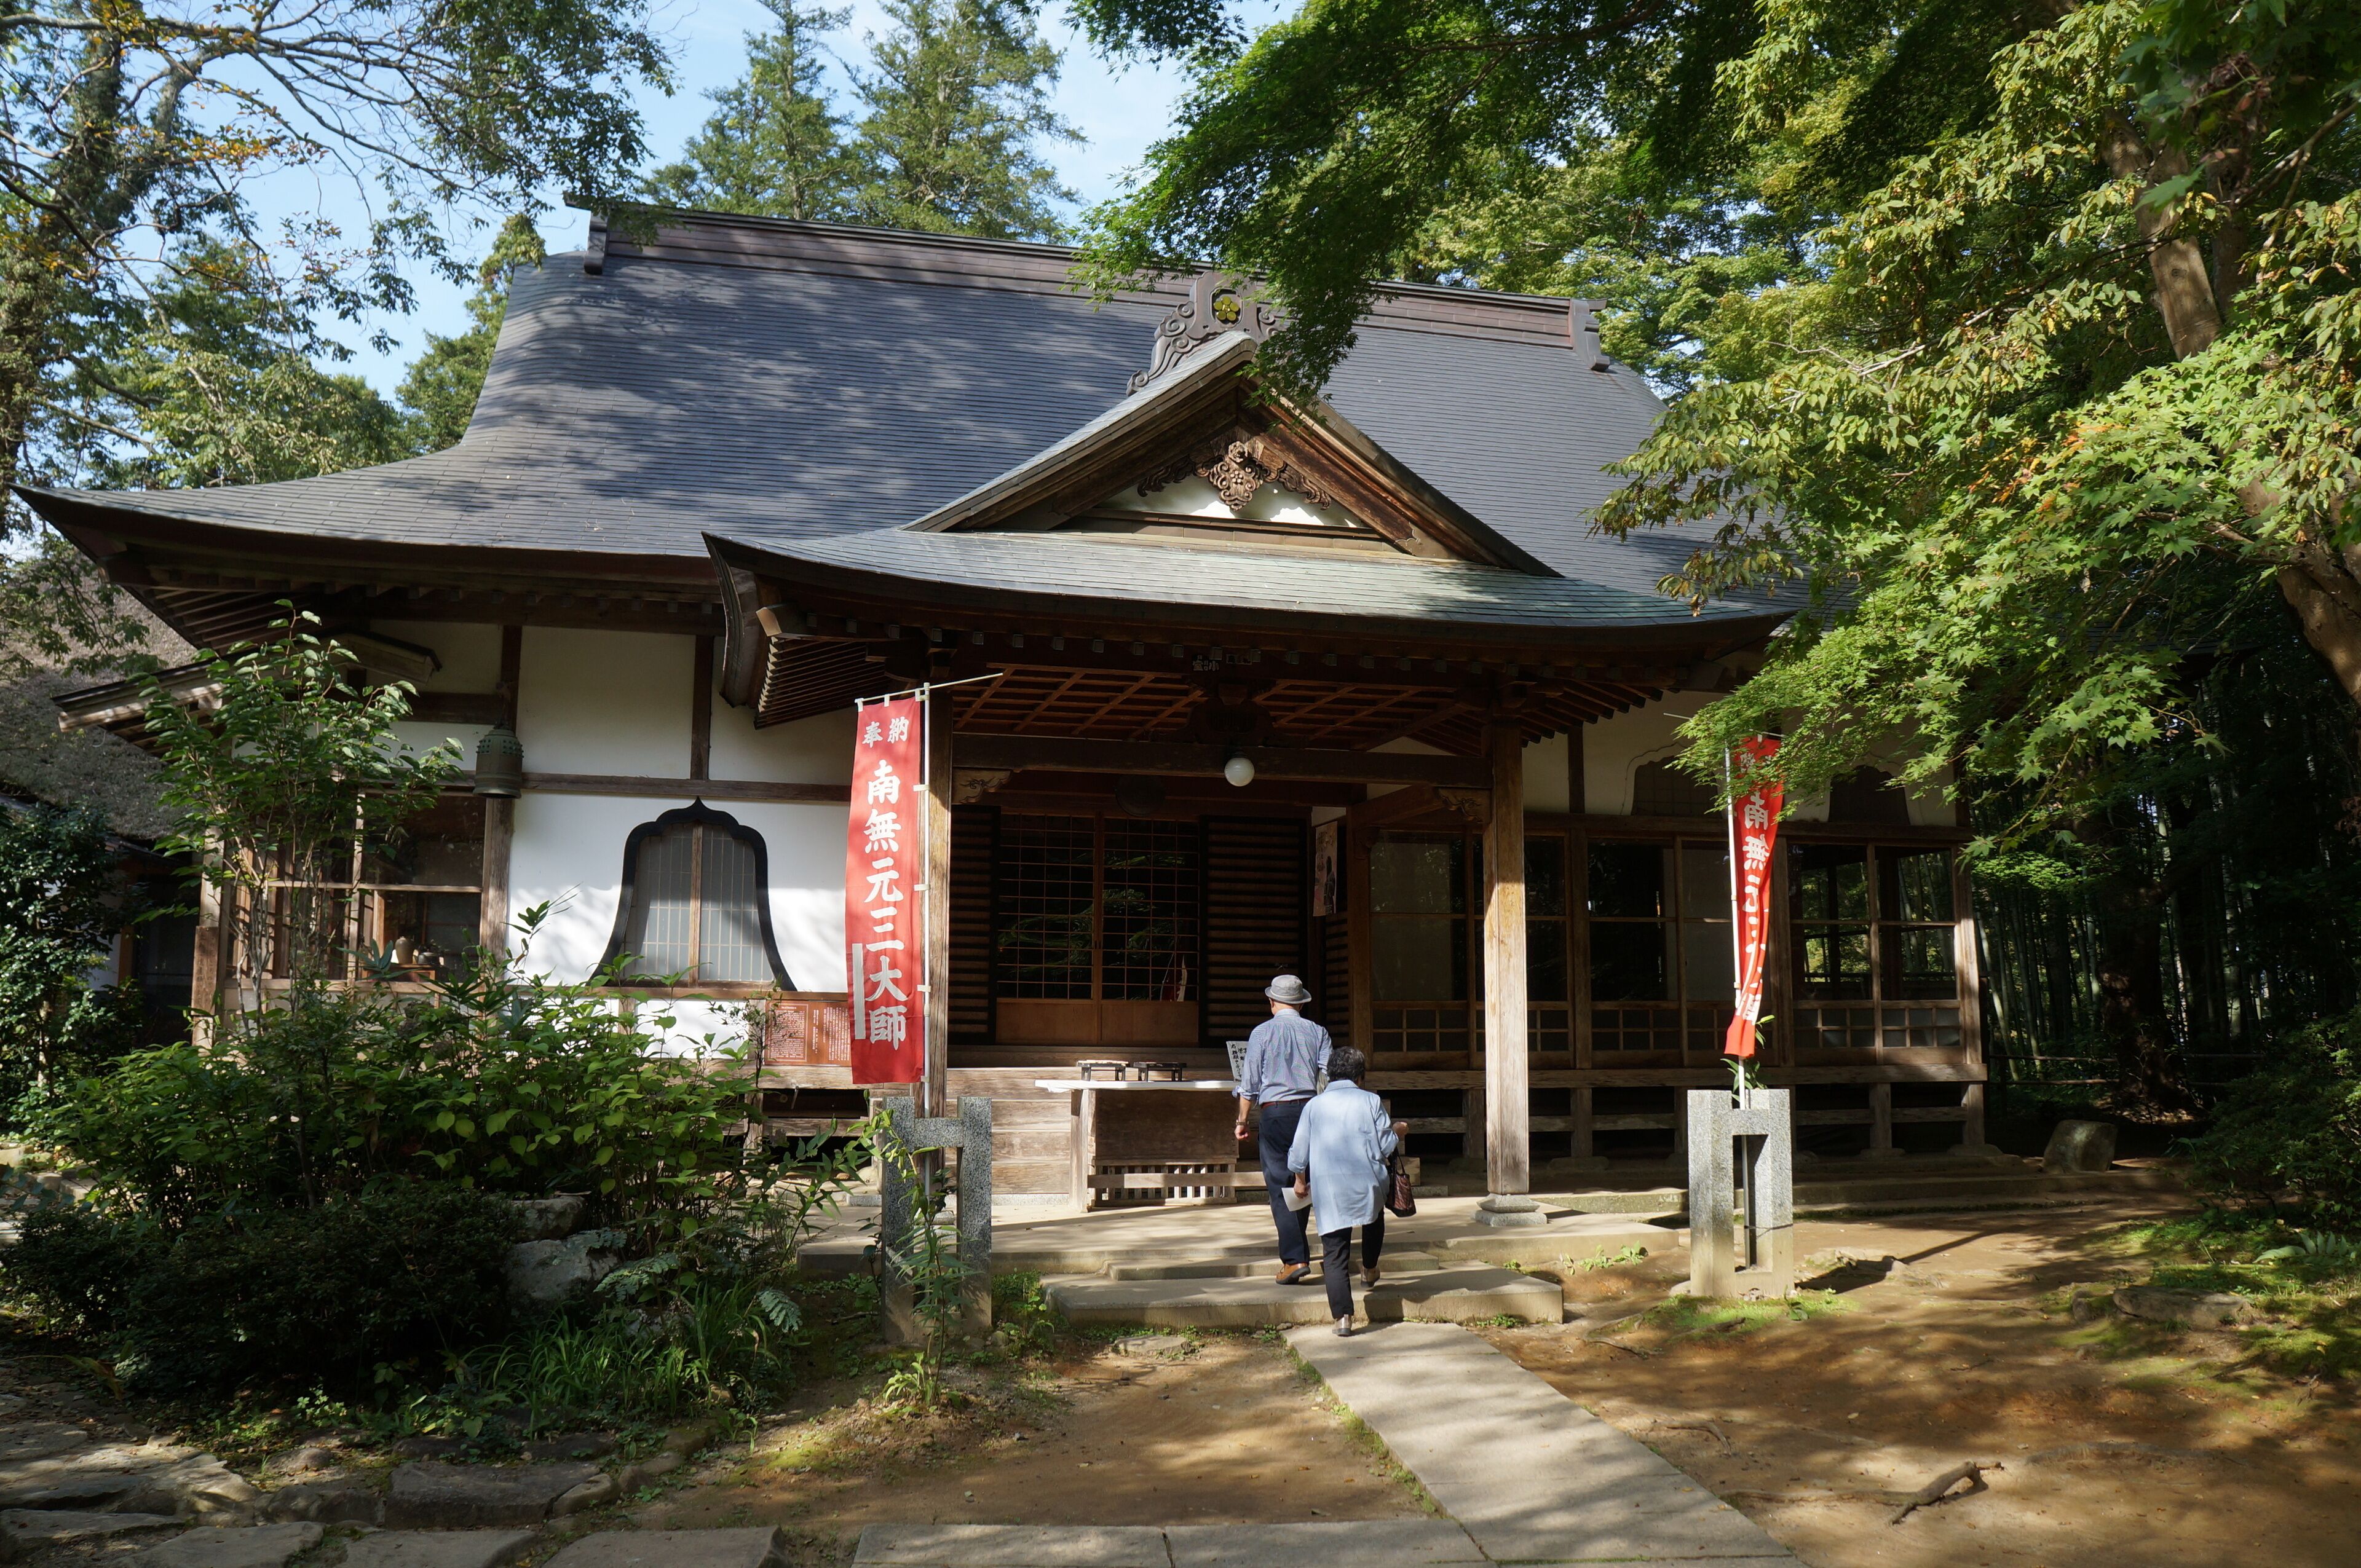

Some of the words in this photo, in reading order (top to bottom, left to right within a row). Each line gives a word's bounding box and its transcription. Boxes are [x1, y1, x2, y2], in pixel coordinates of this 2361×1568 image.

[862, 716, 909, 748] 奉納
[863, 760, 908, 1050] 南無元三大師
